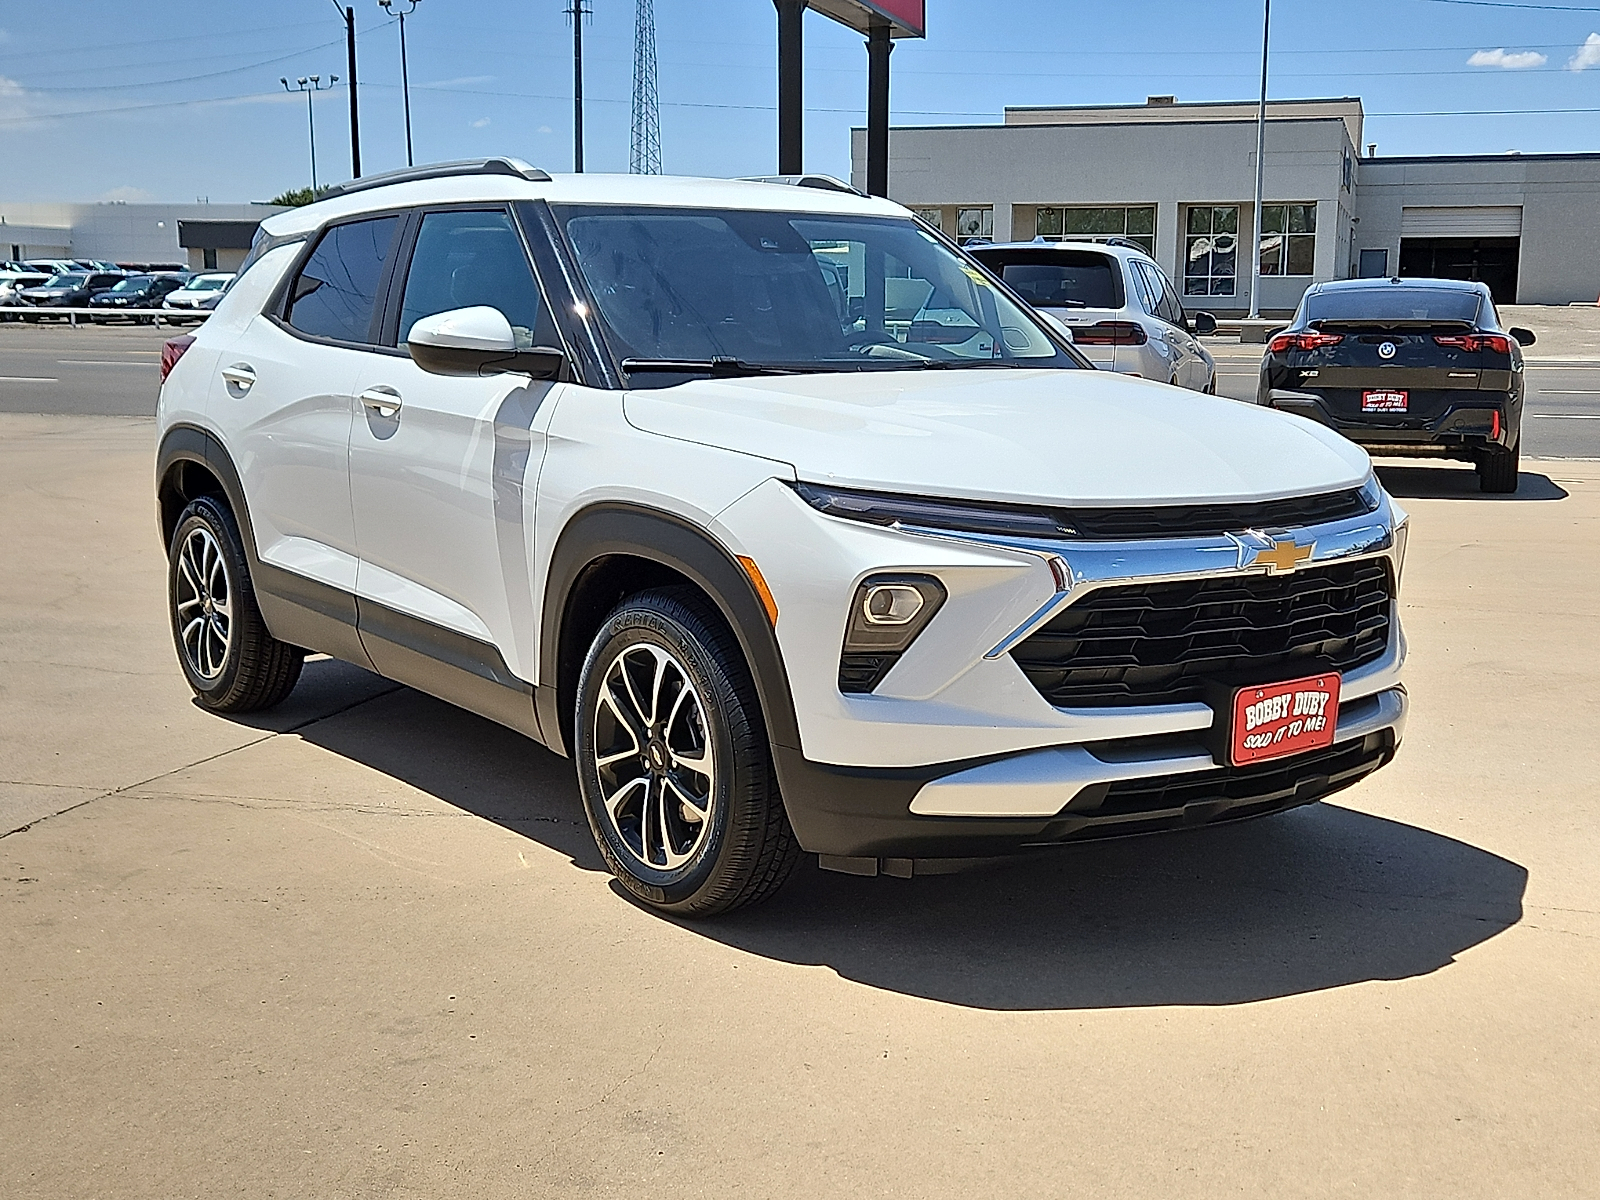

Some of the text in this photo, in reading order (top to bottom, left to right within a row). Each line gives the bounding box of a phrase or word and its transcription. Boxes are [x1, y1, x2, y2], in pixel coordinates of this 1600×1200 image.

[1245, 691, 1330, 731] BOBBY DUBY
[1243, 716, 1327, 749] SOLD IT TO ME!
